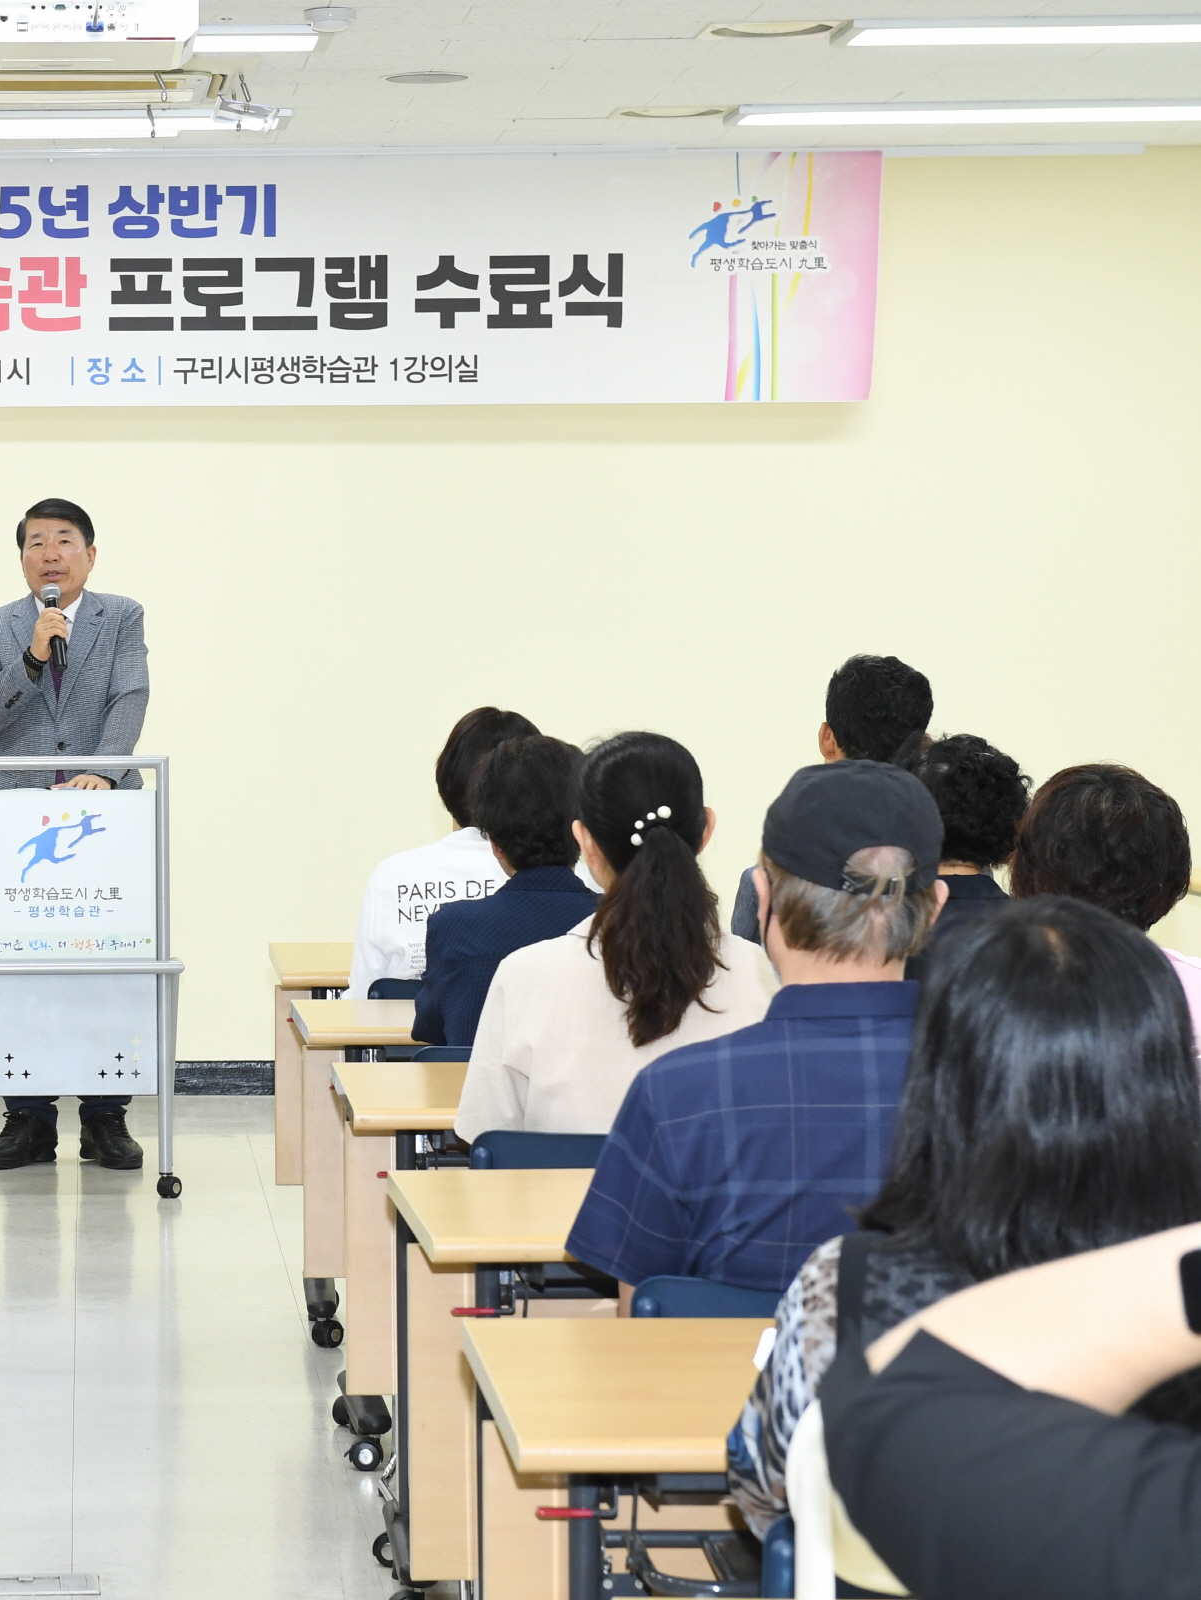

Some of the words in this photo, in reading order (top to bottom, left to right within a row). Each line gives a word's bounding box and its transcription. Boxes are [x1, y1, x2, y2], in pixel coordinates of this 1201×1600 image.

[107, 183, 277, 239] 상반기
[751, 240, 787, 251] 찾아가는
[789, 240, 818, 250] 맞춤식
[709, 257, 792, 272] 평생학습도시
[798, 256, 828, 270] 九里
[108, 254, 389, 332] 프로그램
[414, 252, 624, 330] 수료식
[173, 354, 379, 385] 구리시평생학습관
[389, 354, 479, 384] 1강의실
[3, 887, 88, 902] 평생학습도시
[93, 887, 123, 901] 九里
[397, 880, 457, 904] PARIS
[397, 903, 445, 925] NEV
[70, 938, 107, 955] 행복한
[109, 939, 137, 951] 구리시
